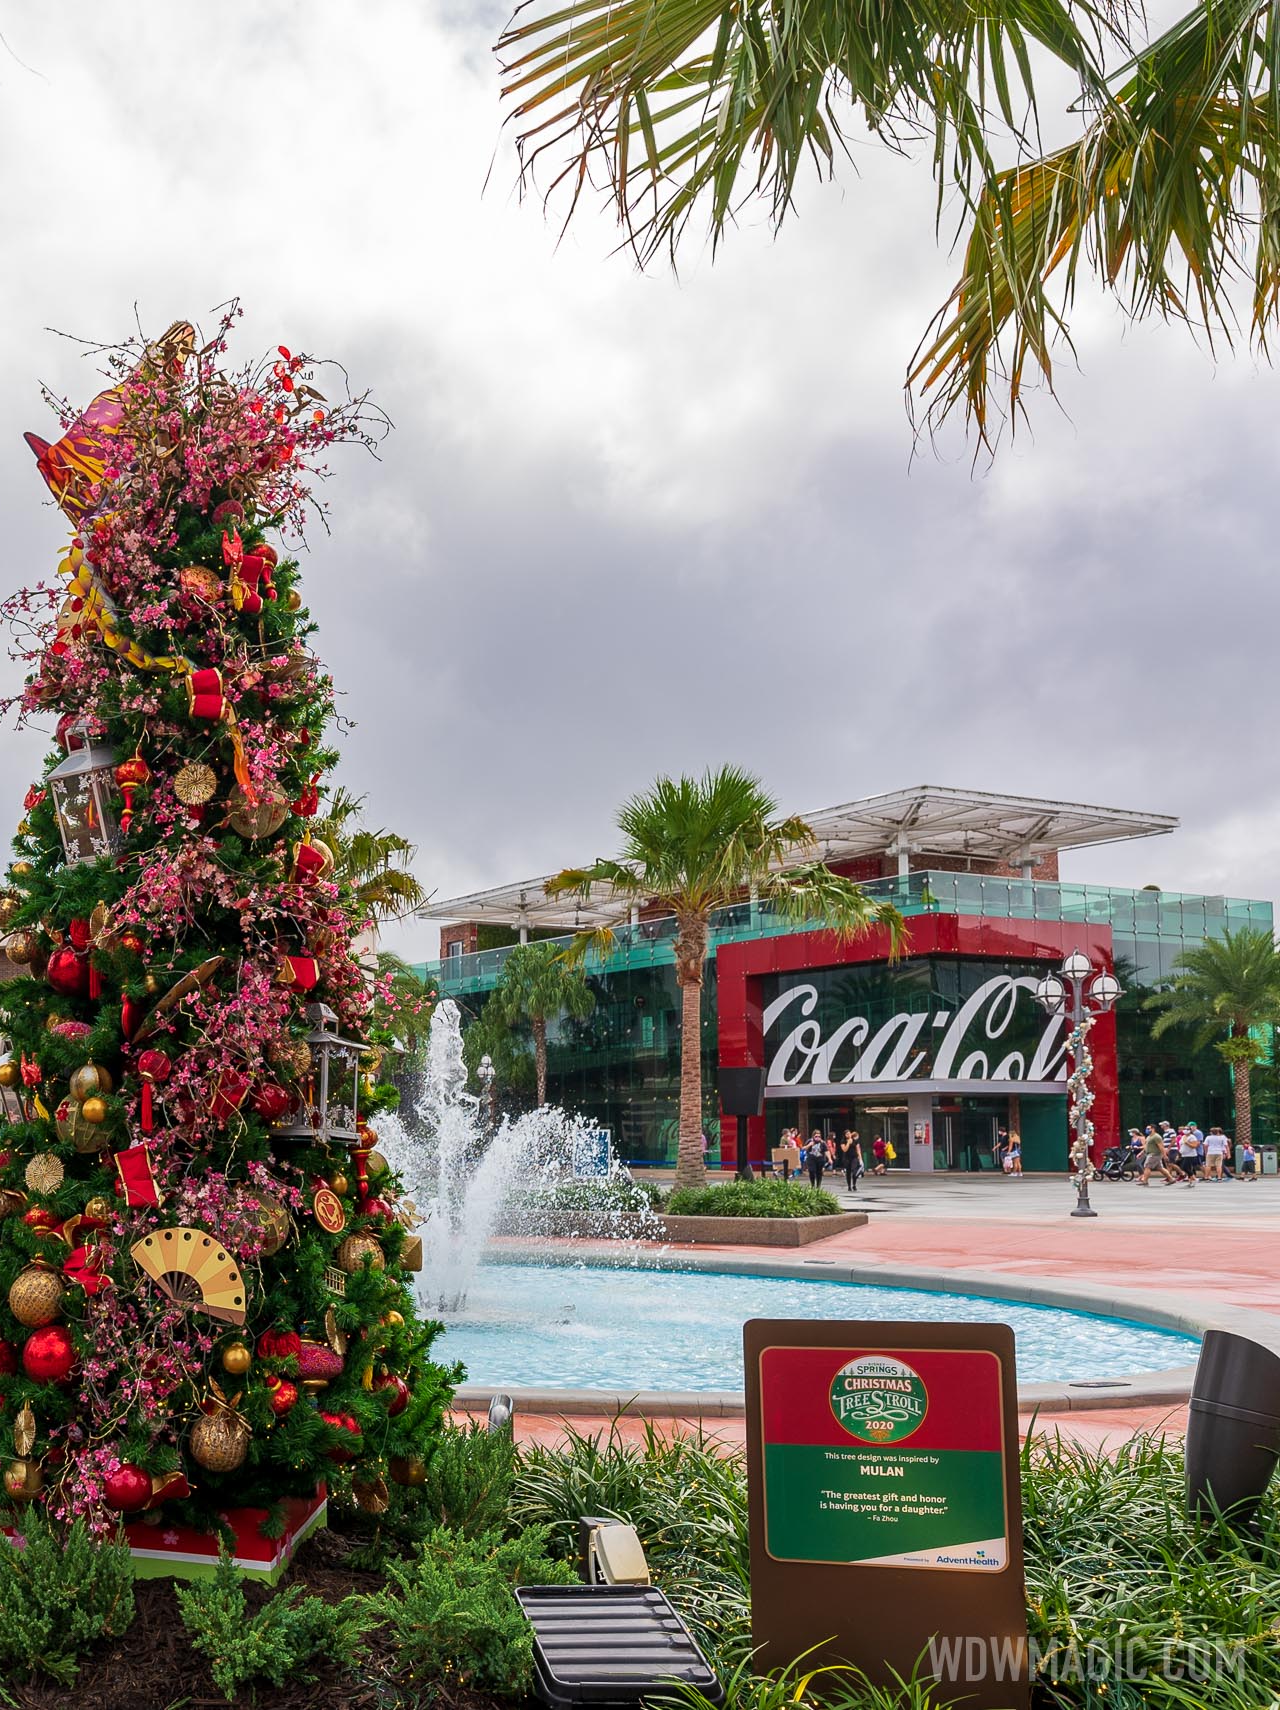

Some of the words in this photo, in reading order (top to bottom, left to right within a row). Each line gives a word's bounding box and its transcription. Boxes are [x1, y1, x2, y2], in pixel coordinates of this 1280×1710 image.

[763, 975, 1067, 1085] Coca-Col
[857, 1365, 898, 1375] SPRINGS
[844, 1378, 912, 1392] CHRISTMAS
[865, 1421, 894, 1430] 2020
[824, 1452, 839, 1460] This
[857, 1453, 882, 1462] design
[898, 1455, 928, 1464] inspired
[930, 1456, 940, 1465] by
[860, 1465, 904, 1477] MULAN
[843, 1492, 881, 1502] greatest
[882, 1493, 899, 1502] gift
[900, 1494, 918, 1503] and
[919, 1494, 947, 1503] honor
[819, 1501, 827, 1509] is
[829, 1501, 859, 1512] having
[860, 1504, 877, 1512] you
[879, 1503, 893, 1512] for
[936, 1555, 999, 1566] AdventHealth
